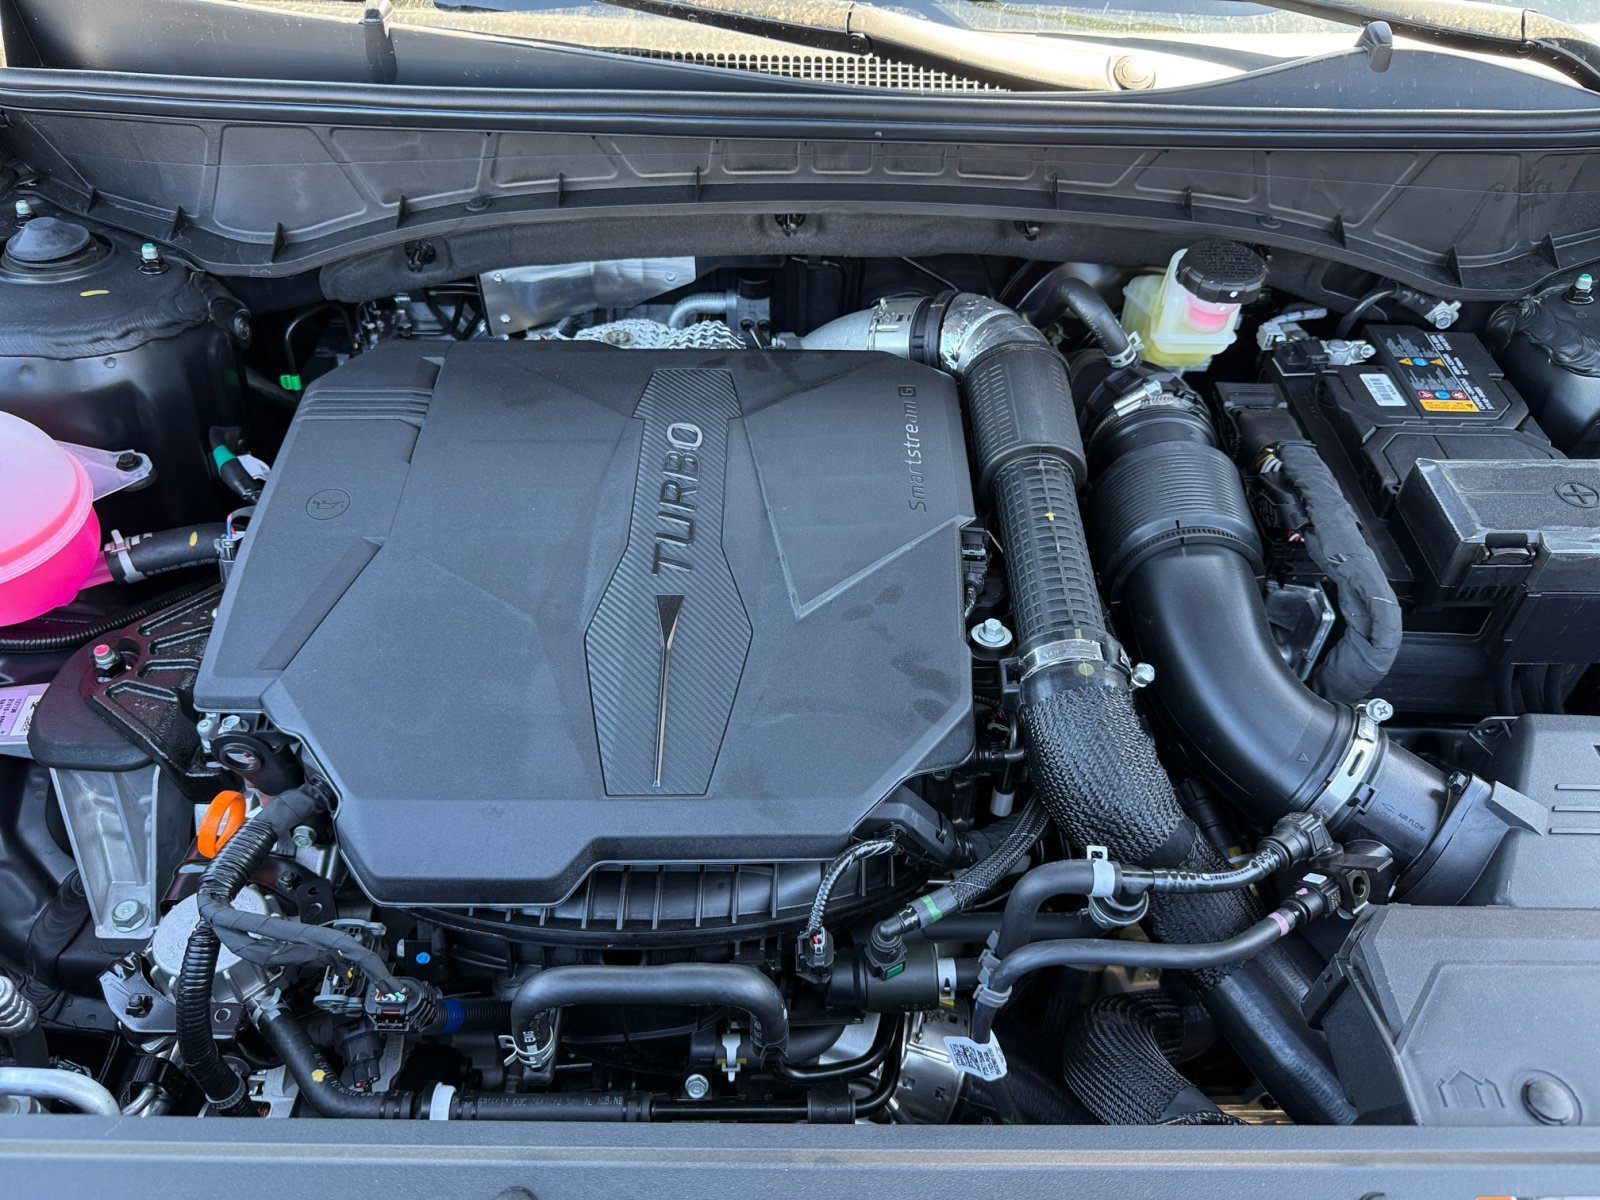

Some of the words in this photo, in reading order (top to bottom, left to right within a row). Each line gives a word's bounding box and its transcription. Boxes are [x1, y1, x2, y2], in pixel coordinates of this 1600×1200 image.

[898, 384, 917, 397] G
[904, 400, 927, 512] Smartstream
[652, 422, 703, 576] TURBO
[1397, 812, 1409, 822] AIR
[1408, 818, 1426, 832] FLOW
